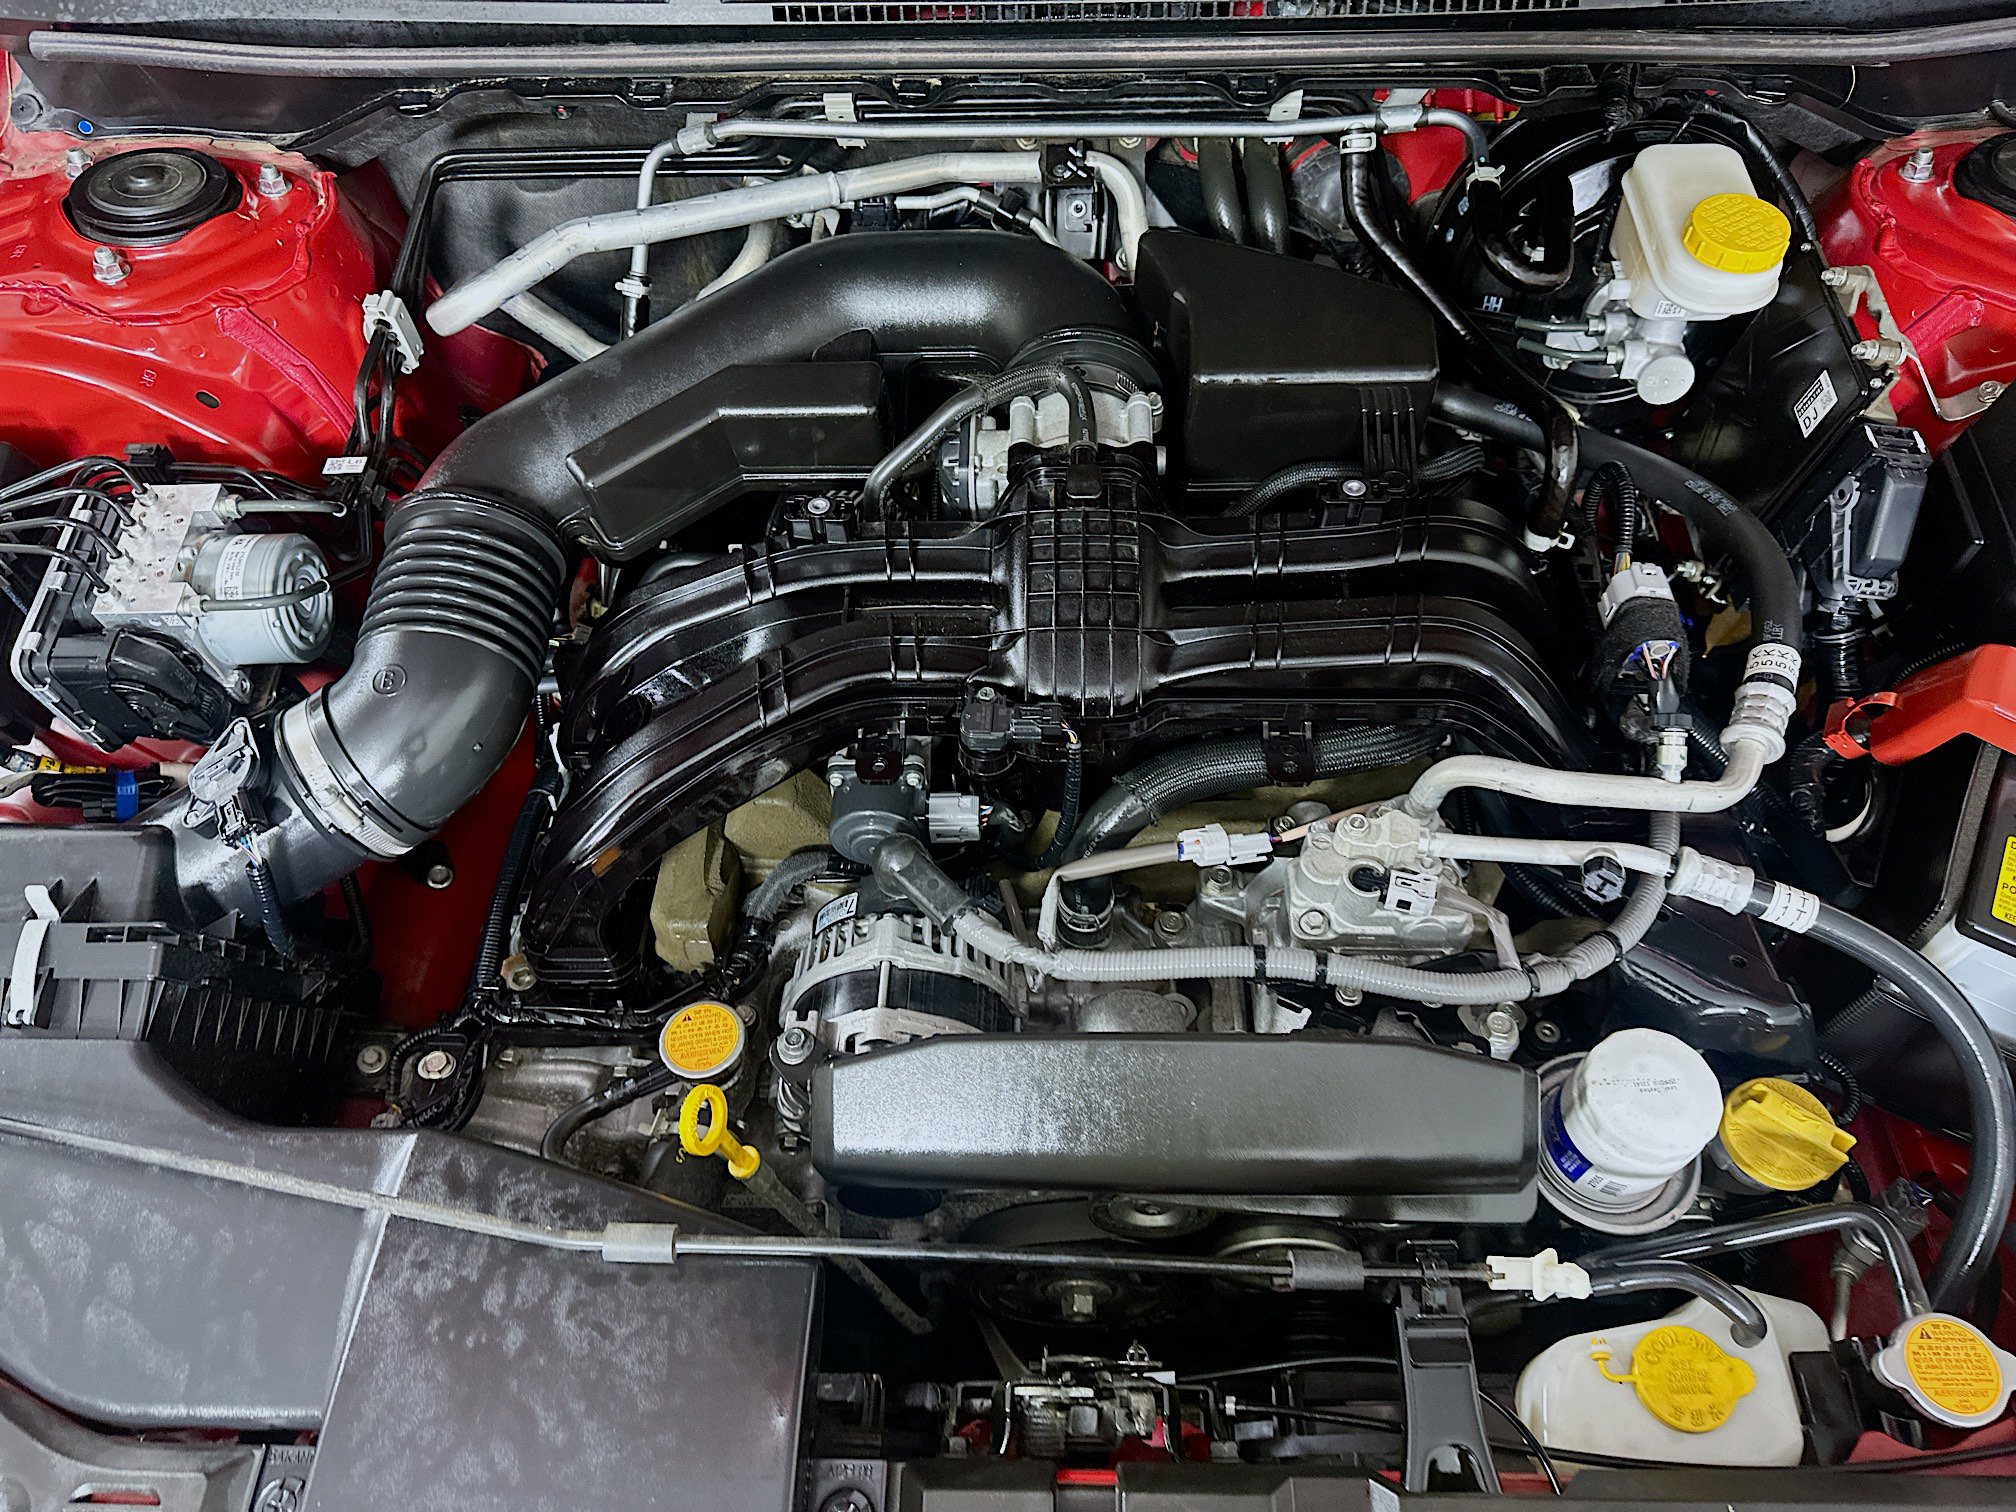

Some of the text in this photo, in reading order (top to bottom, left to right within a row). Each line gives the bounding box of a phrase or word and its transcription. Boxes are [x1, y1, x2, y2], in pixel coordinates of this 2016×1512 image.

[140, 369, 157, 387] GR
[380, 669, 395, 689] B
[1586, 873, 1618, 900] H
[1641, 1329, 1724, 1365] COOLANT
